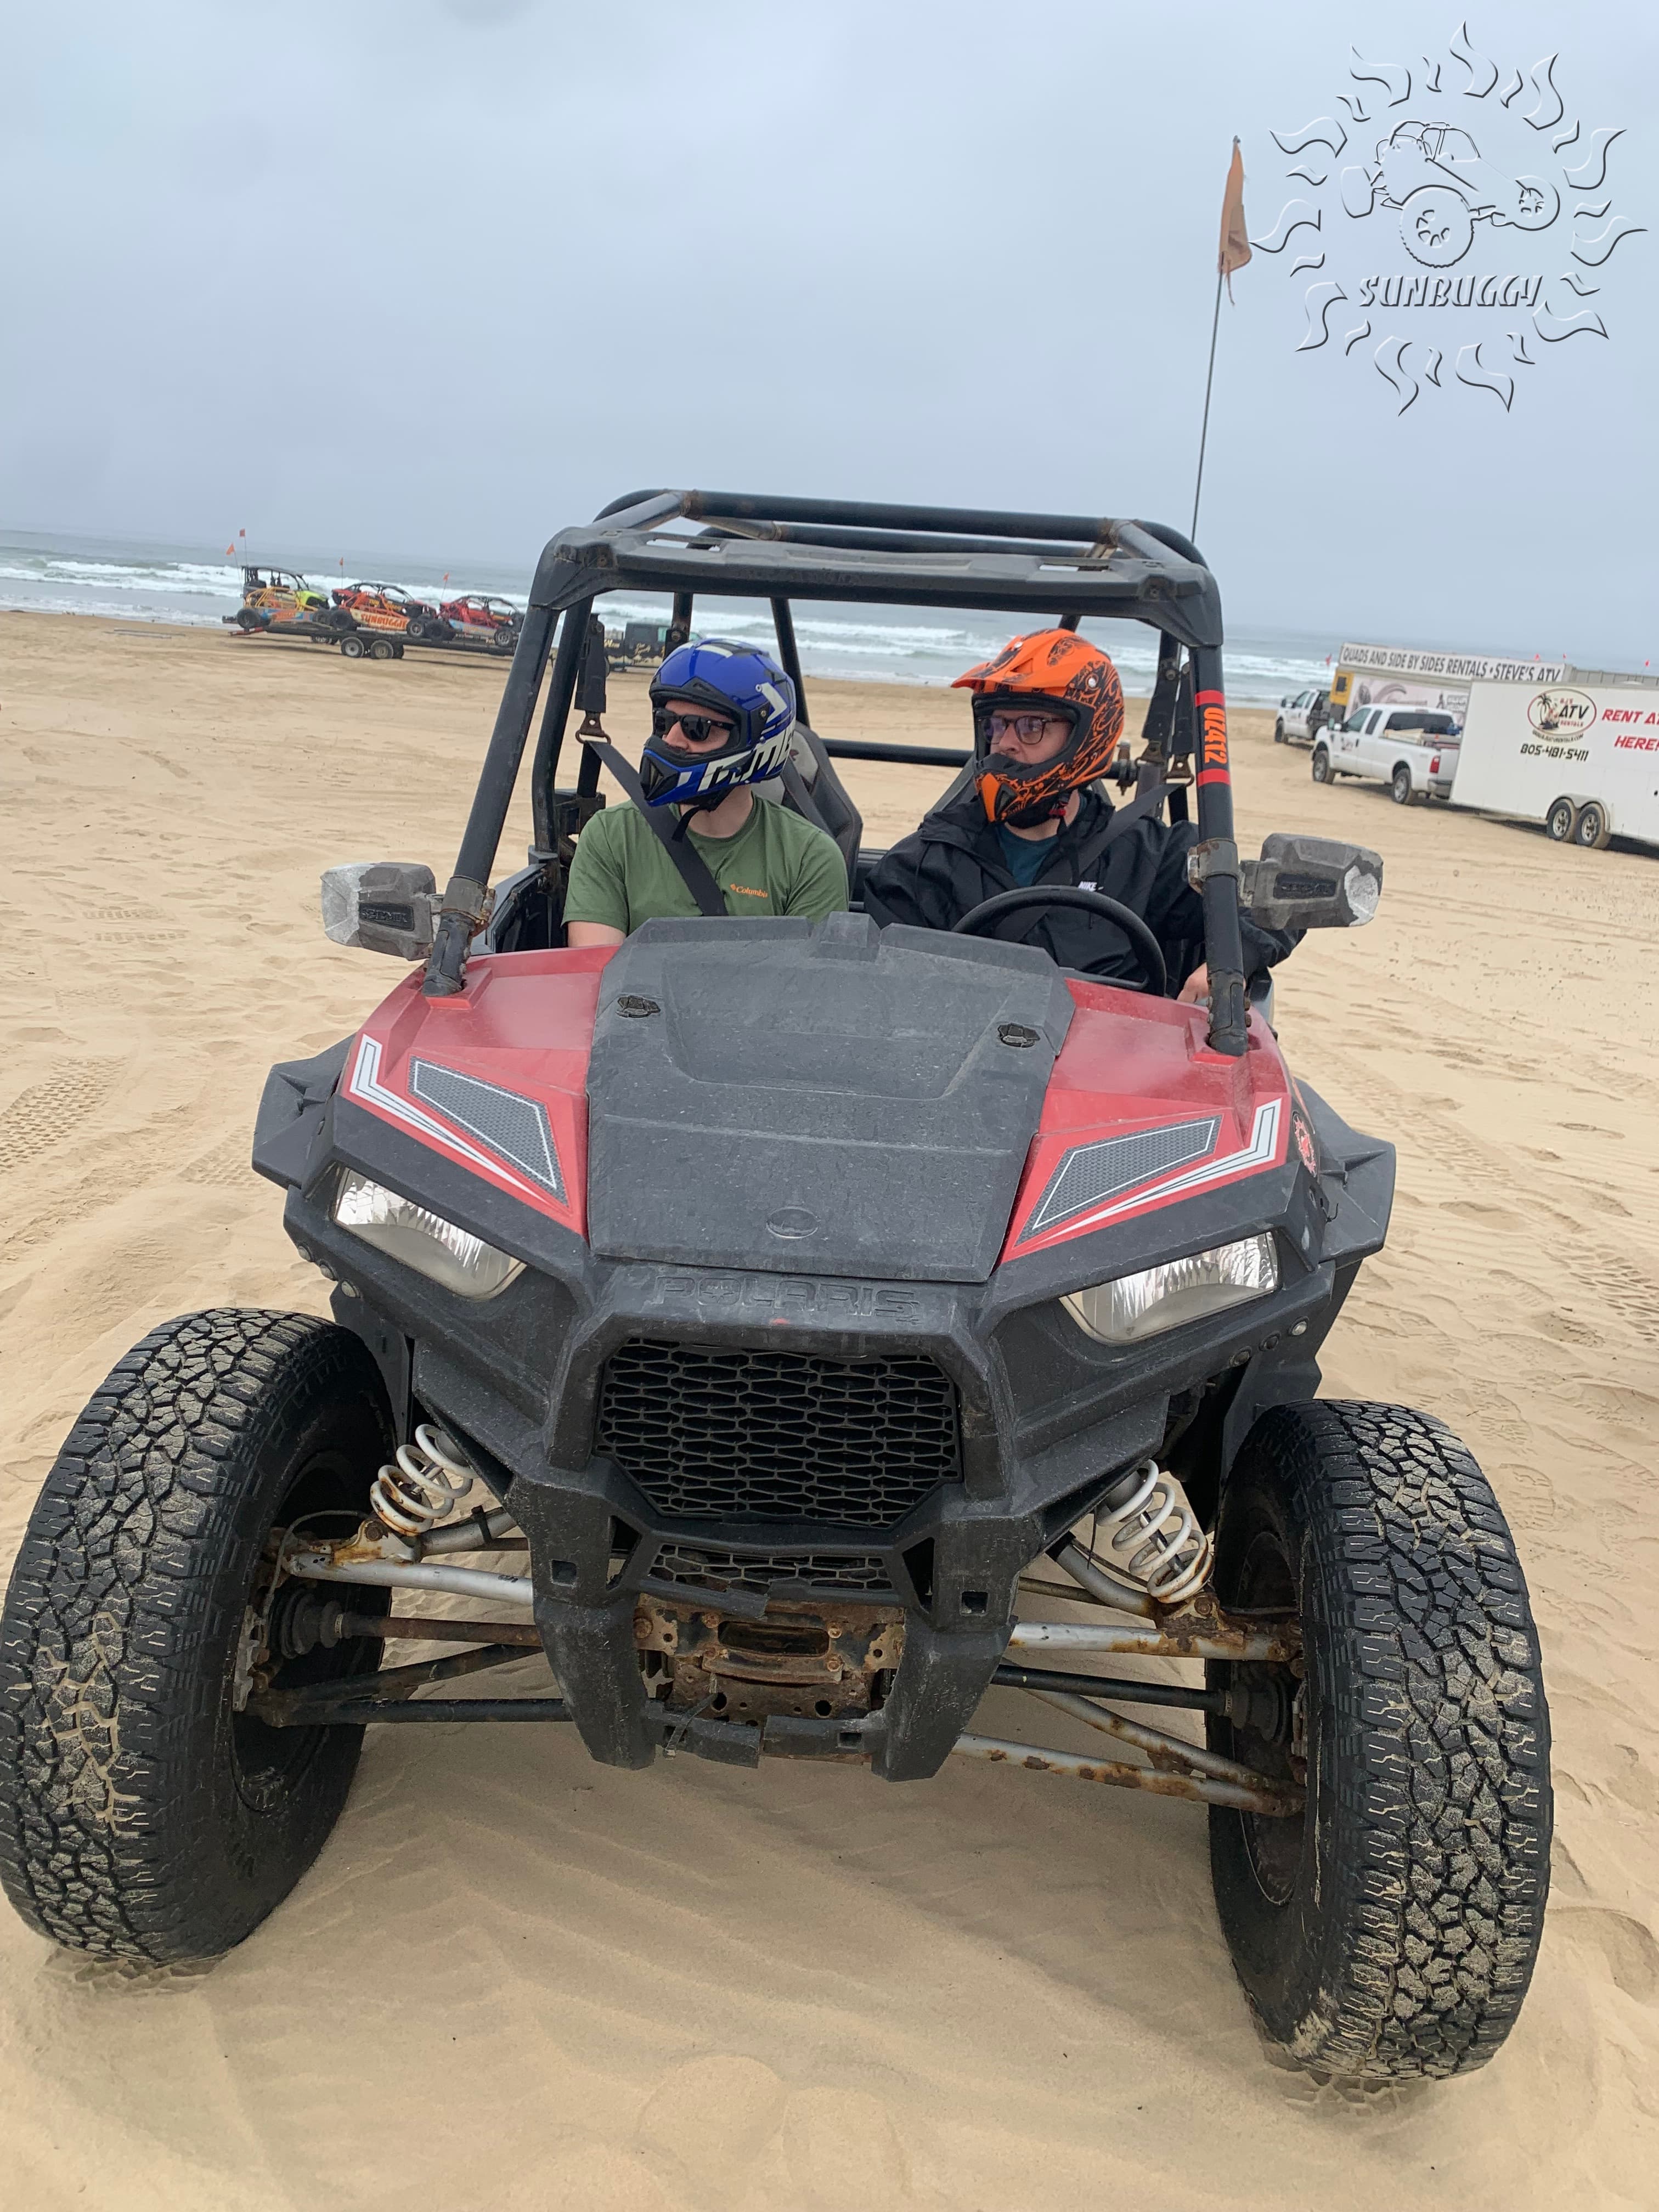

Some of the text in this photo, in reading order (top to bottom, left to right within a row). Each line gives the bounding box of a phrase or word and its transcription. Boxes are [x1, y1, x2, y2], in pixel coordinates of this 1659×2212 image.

[1343, 647, 1561, 681] QUADS AND SIDE BY SIDES RENTALS STEVE'S ATV
[1559, 705, 1589, 719] ATV
[1602, 708, 1659, 725] RENT A
[1204, 707, 1227, 764] UZ412
[1078, 881, 1097, 892] NIKE
[654, 1276, 918, 1317] POLARIS
